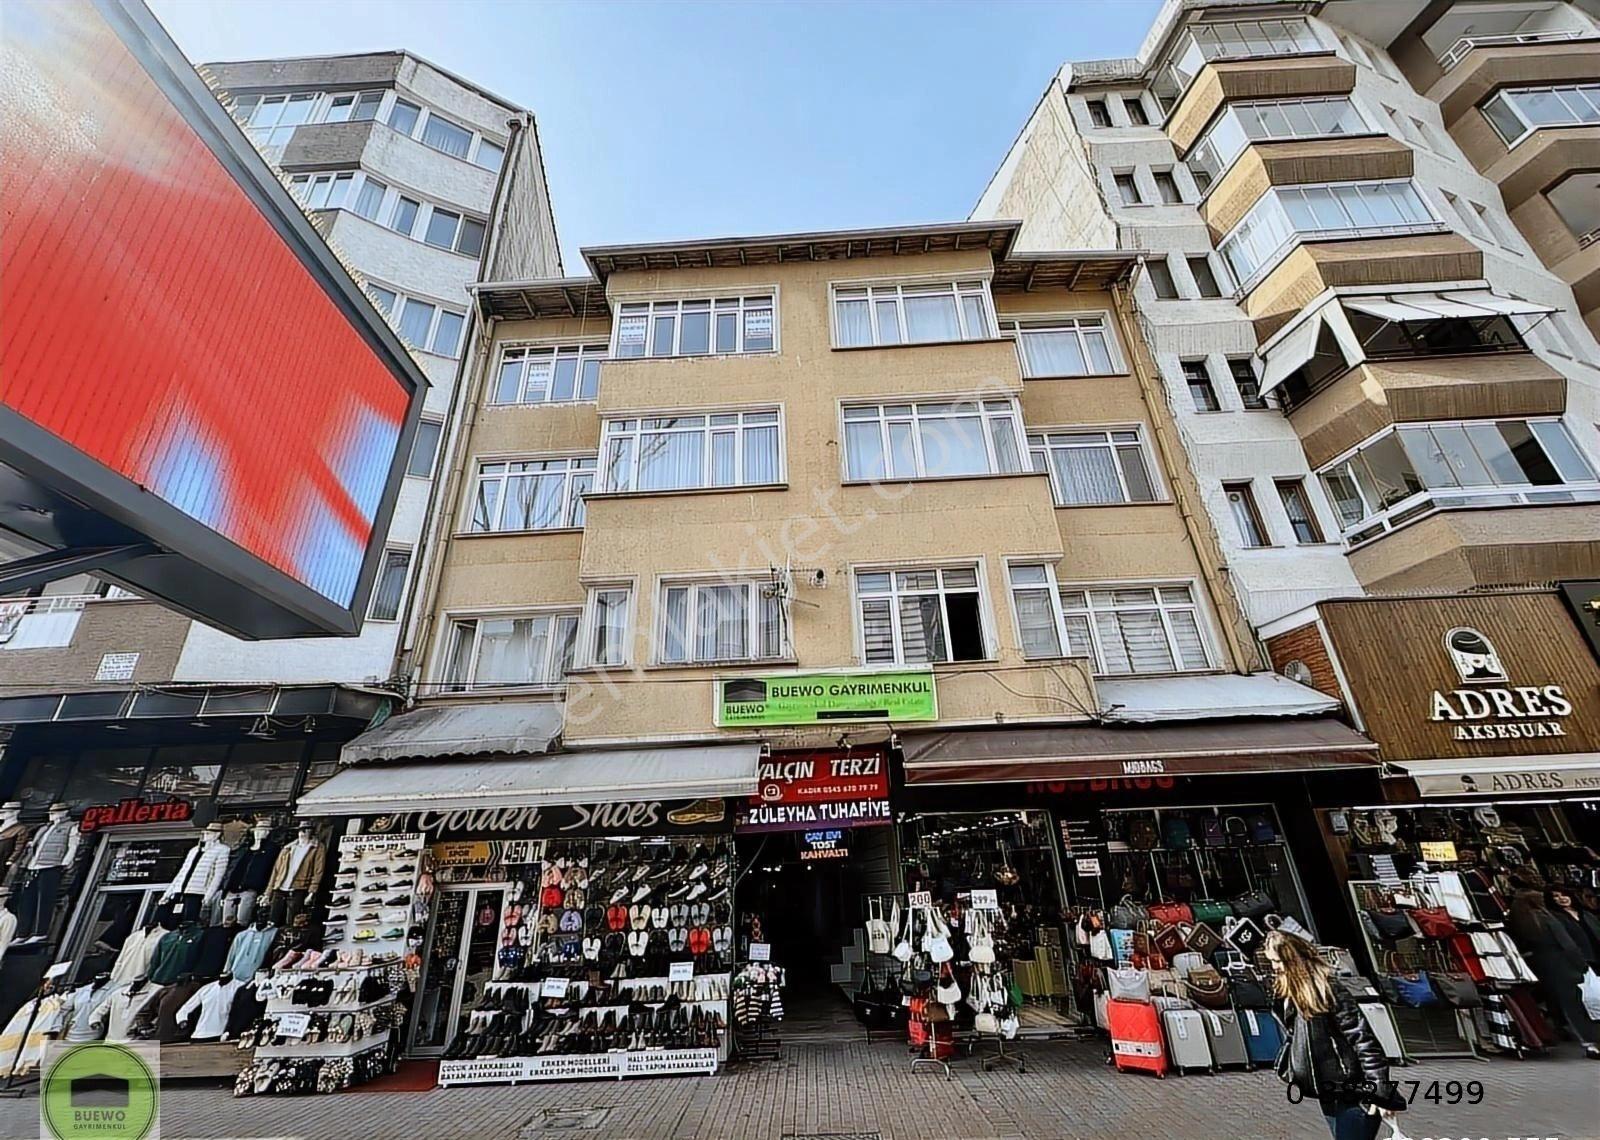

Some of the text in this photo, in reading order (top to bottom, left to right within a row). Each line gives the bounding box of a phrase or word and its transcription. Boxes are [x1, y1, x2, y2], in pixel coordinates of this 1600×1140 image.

[772, 682, 930, 698] BUEWO GAYRIMENKUL
[726, 704, 765, 714] BUEWO
[1430, 685, 1572, 721] ADRES
[1454, 722, 1566, 740] AKSESUAR
[830, 753, 880, 777] TERZİ
[1492, 772, 1564, 791] ADRES
[81, 799, 190, 831] galleria
[749, 804, 817, 824] ZÜLEYHA
[819, 797, 891, 823] TUHAFİYE
[505, 840, 544, 863] 450 TL
[811, 840, 837, 849] TOST
[800, 848, 849, 860] KAHVALTI
[909, 893, 931, 906] 200
